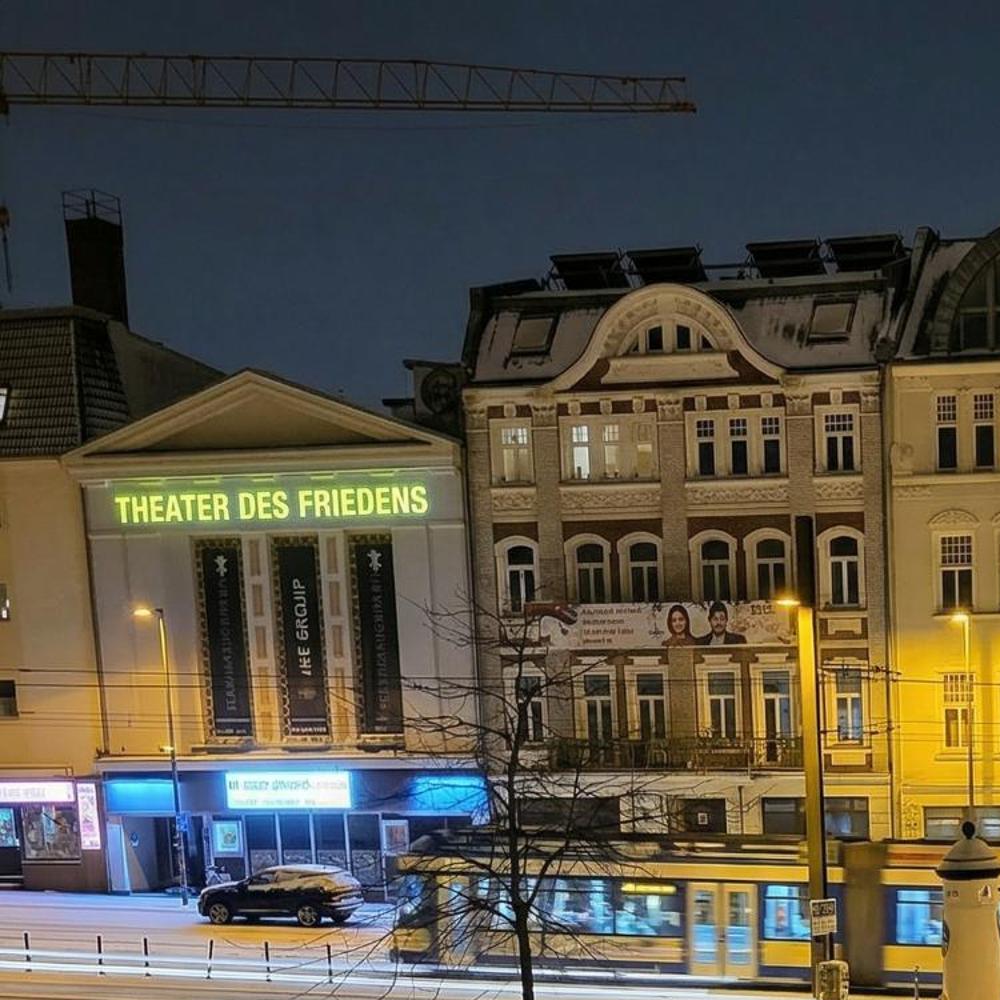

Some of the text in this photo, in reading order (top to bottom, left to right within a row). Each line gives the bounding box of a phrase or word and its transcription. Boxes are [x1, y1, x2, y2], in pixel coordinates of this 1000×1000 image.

[115, 485, 429, 524] THEATER DES FRIEDENS
